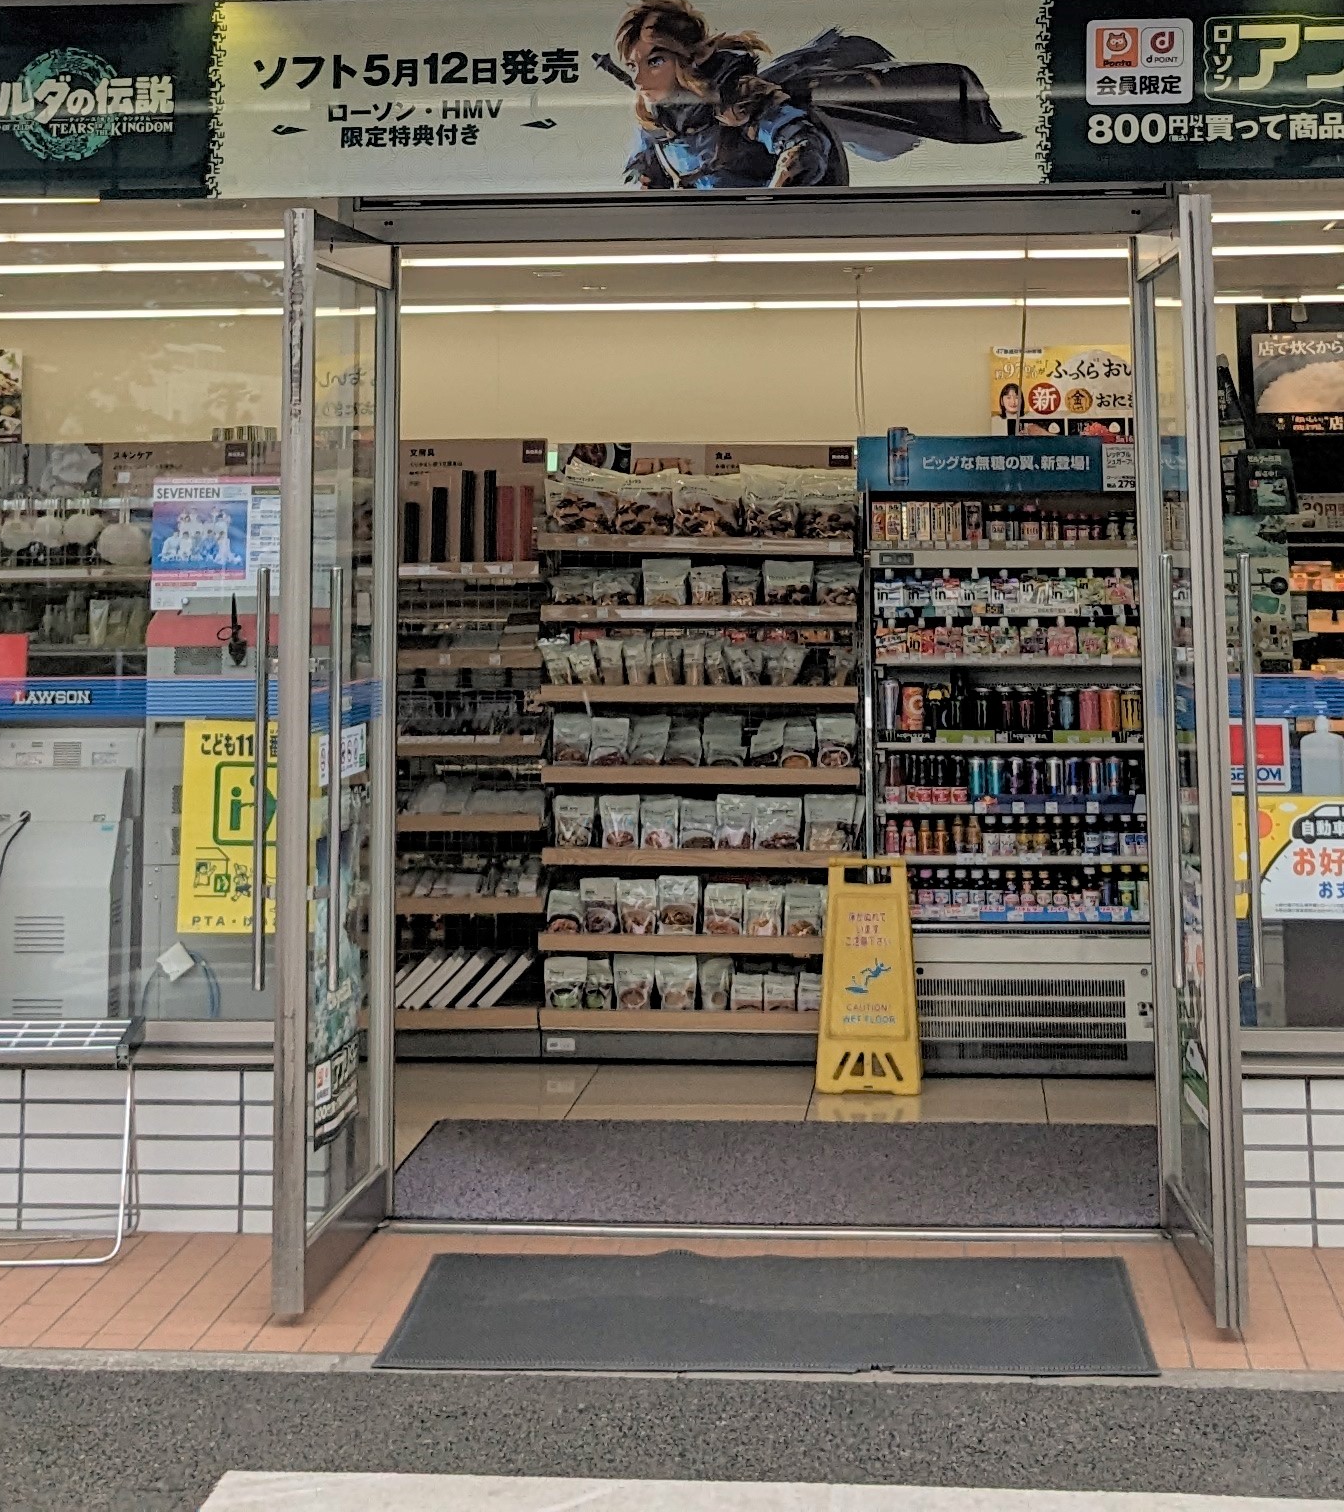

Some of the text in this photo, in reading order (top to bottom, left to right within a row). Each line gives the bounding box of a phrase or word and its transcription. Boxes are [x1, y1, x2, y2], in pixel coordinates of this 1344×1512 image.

[253, 48, 580, 90] ソフト5月12日発売
[1213, 25, 1233, 92] ローソン
[1096, 75, 1183, 96] 会員限定
[327, 98, 504, 124] ローソン・HMV
[49, 124, 95, 137] TEARS
[110, 121, 174, 137] KINGDOM
[340, 125, 480, 148] 限定特典付き
[1032, 386, 1057, 412] 新
[921, 454, 1090, 472] ビッグな無糖の翼、新登場!
[156, 487, 221, 500] SEVENTEEN
[14, 689, 91, 705] LAWSON
[1231, 767, 1282, 781] EOM
